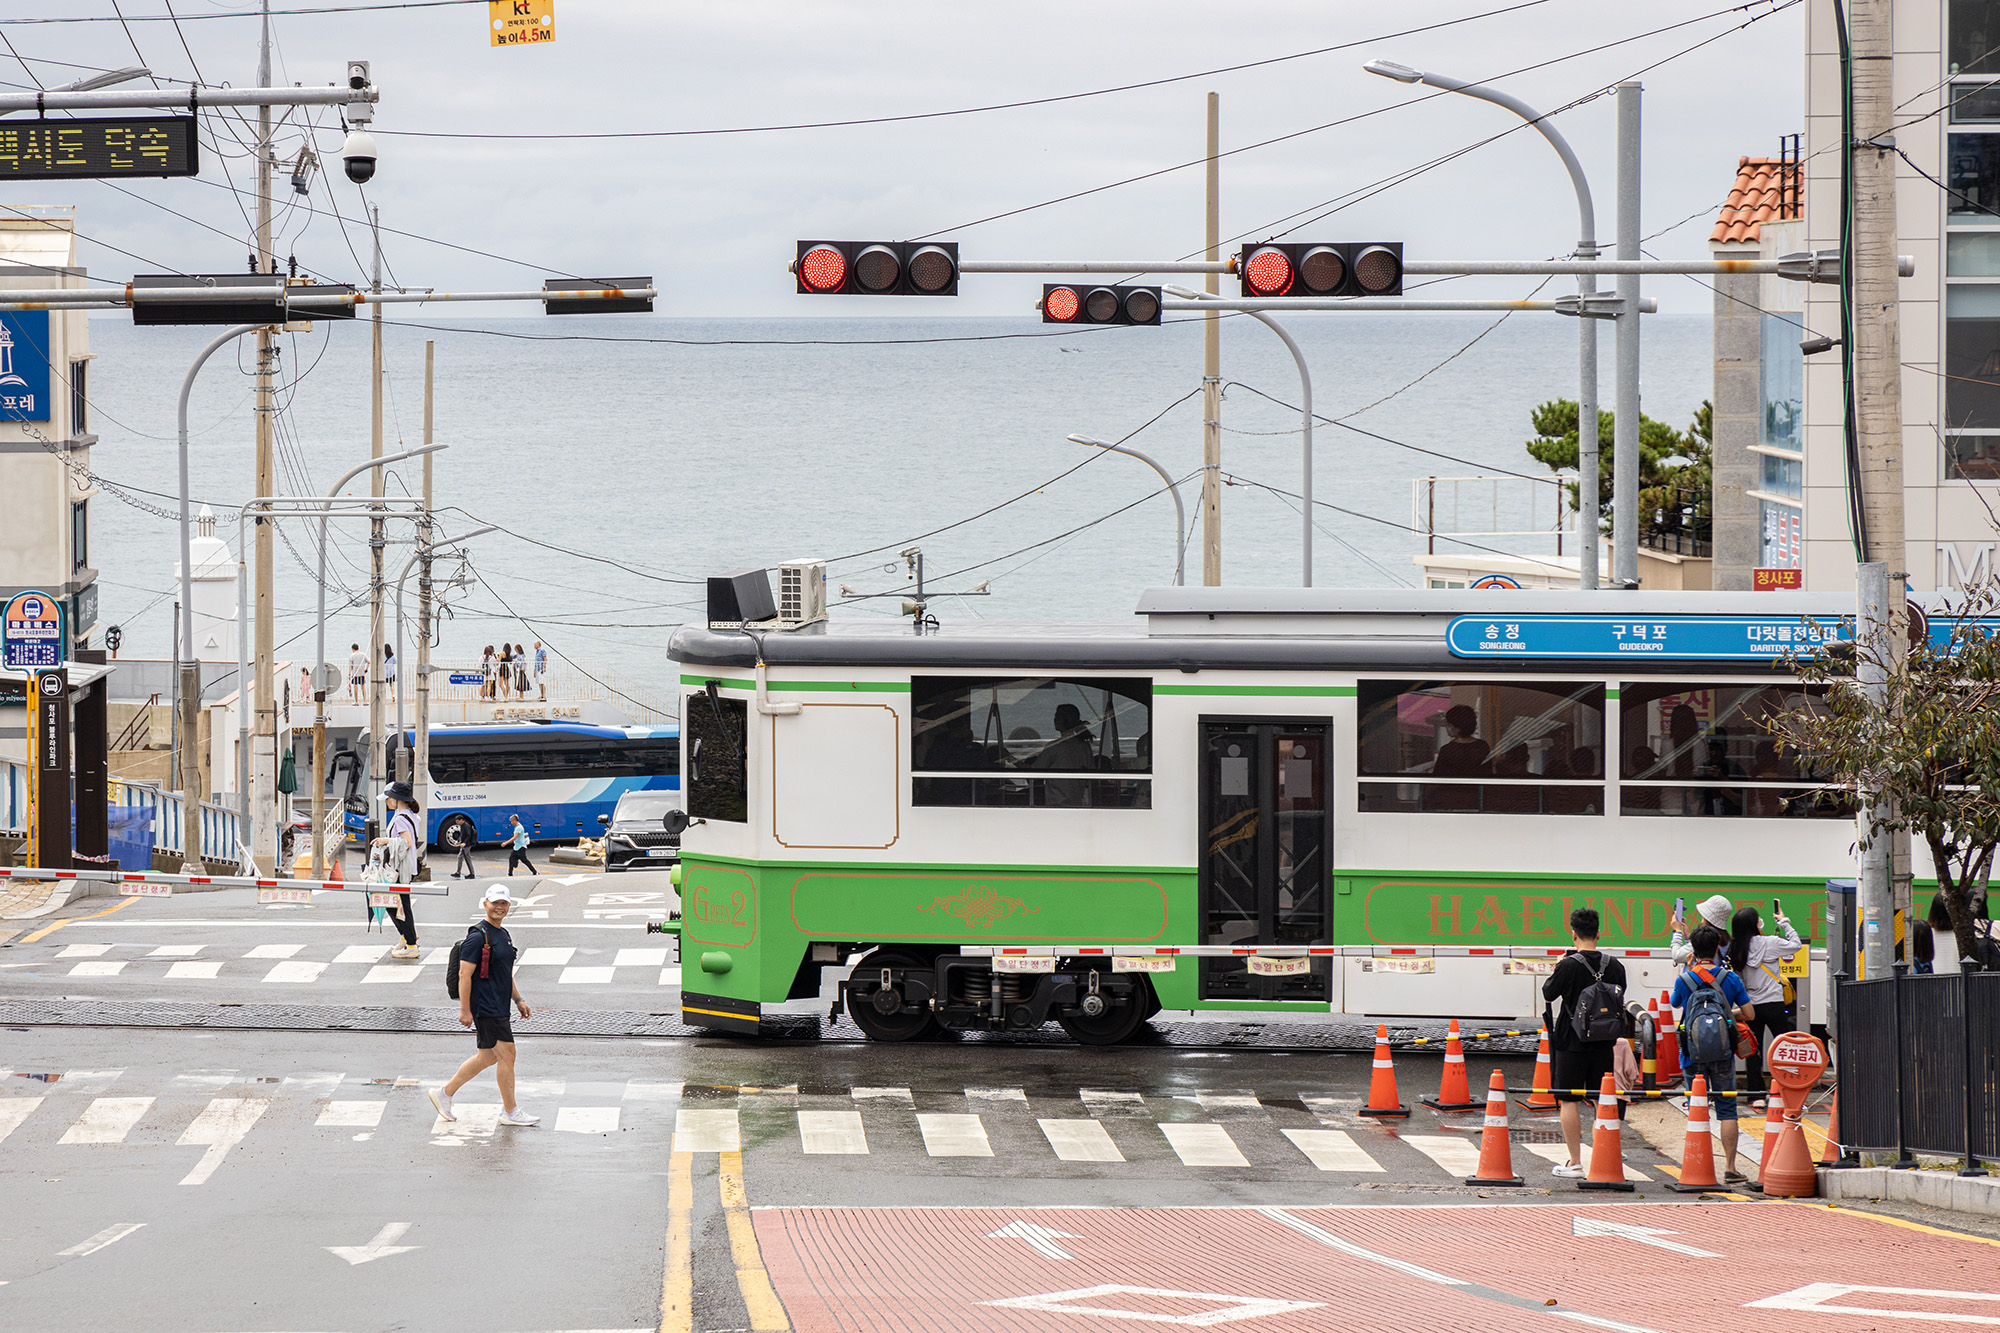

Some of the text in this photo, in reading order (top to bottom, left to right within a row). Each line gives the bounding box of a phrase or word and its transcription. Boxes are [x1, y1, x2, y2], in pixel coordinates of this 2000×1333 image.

[513, 0, 531, 15] kt
[105, 127, 170, 167] 단속
[1757, 571, 1796, 585] 청사포
[11, 620, 54, 629] 마을버스
[1612, 625, 1668, 640] 구덕포
[1747, 626, 1838, 642] 다릿돌전망대
[1479, 641, 1526, 650] SONGJEONG
[1618, 643, 1664, 651] GUDEOKPO
[1008, 960, 1051, 969] 일단정지
[1128, 960, 1171, 969] 일단정지
[1263, 961, 1307, 972] 일단정지
[1387, 960, 1431, 971] 일단정지
[1778, 1048, 1818, 1063] 주차금지
